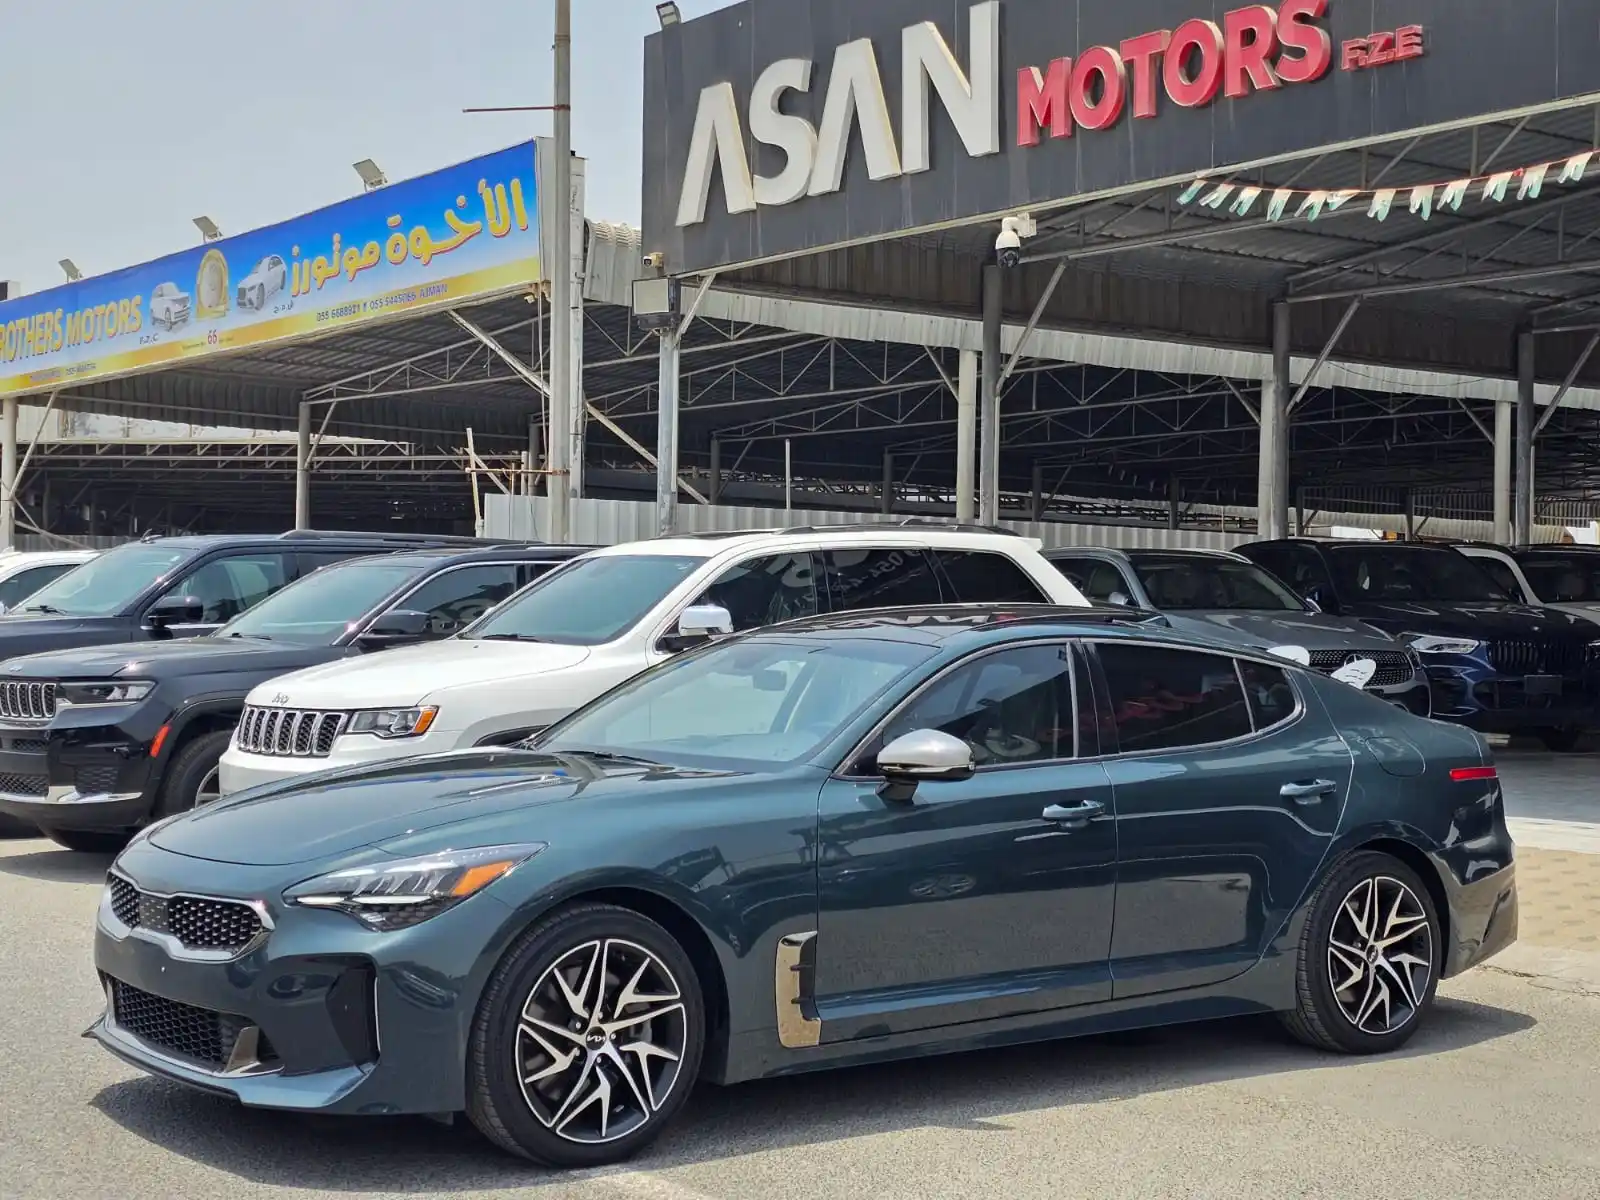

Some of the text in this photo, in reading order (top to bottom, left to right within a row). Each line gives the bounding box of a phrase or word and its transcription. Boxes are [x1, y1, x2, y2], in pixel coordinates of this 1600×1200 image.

[675, 0, 1000, 227] ASAN
[1016, 0, 1332, 147] MOTORS
[291, 178, 528, 297] الأخوة موتورز
[66, 295, 142, 346] MOTORS
